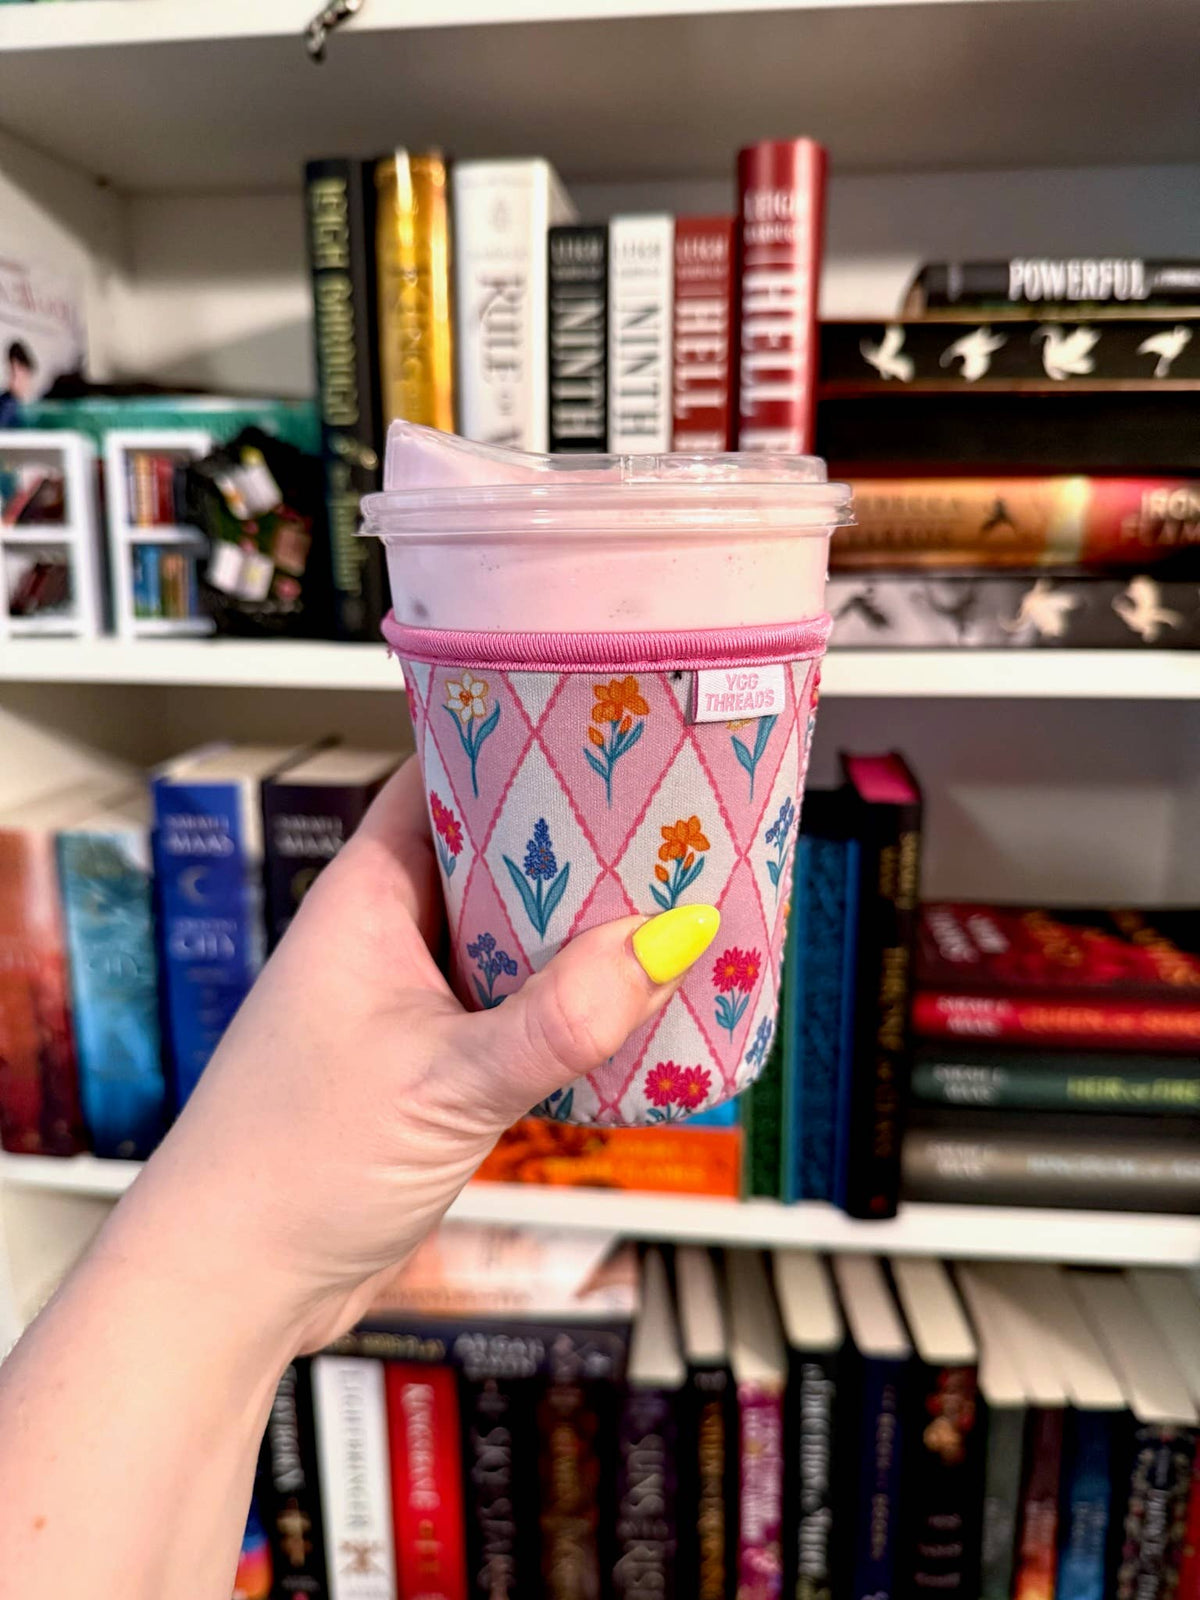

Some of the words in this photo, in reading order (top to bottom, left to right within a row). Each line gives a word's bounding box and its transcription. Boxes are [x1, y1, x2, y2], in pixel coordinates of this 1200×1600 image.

[740, 269, 804, 418] HELL
[1009, 257, 1150, 302] POWERFUL
[552, 299, 606, 439] NINTH
[617, 301, 663, 437] NINTH
[674, 299, 729, 420] HELL
[705, 688, 775, 712] THREADS
